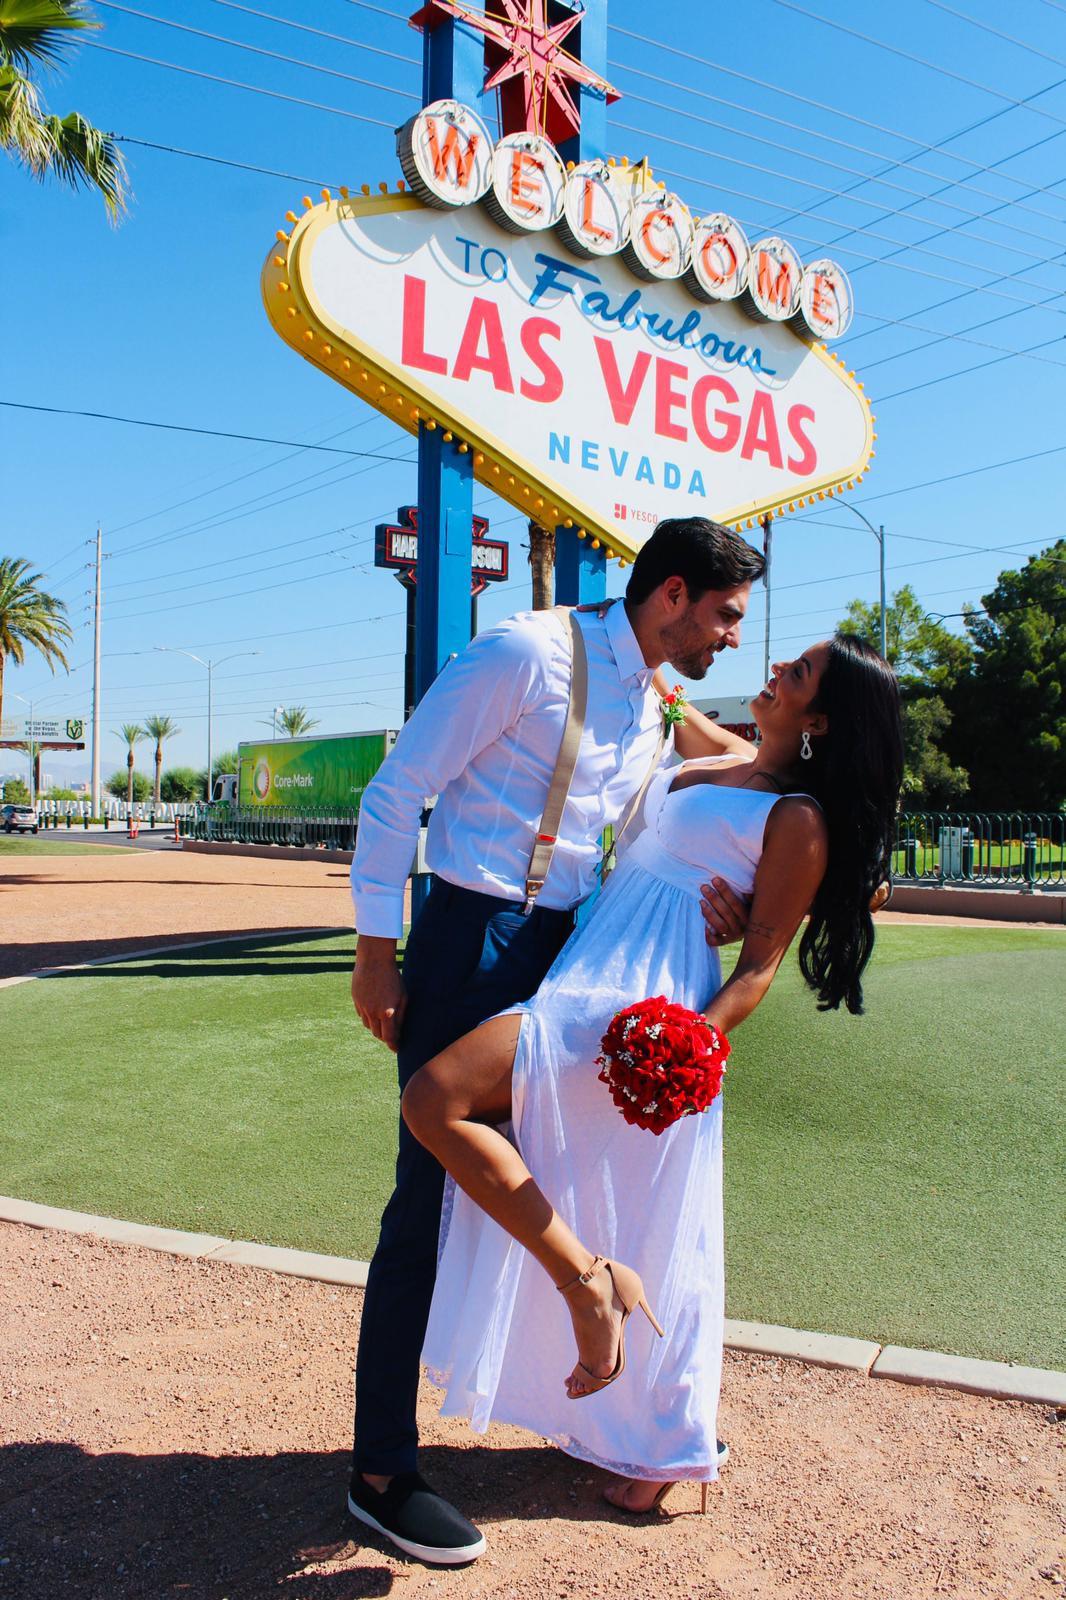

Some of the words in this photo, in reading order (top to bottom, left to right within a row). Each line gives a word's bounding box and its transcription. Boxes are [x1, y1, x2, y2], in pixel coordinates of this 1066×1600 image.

[425, 115, 834, 327] WELCOME
[401, 274, 564, 404] LAS
[594, 337, 818, 476] VEGAS
[455, 236, 508, 283] TO
[528, 253, 776, 375] Fabulous
[548, 431, 707, 498] NEVADA
[630, 508, 658, 526] YESCO
